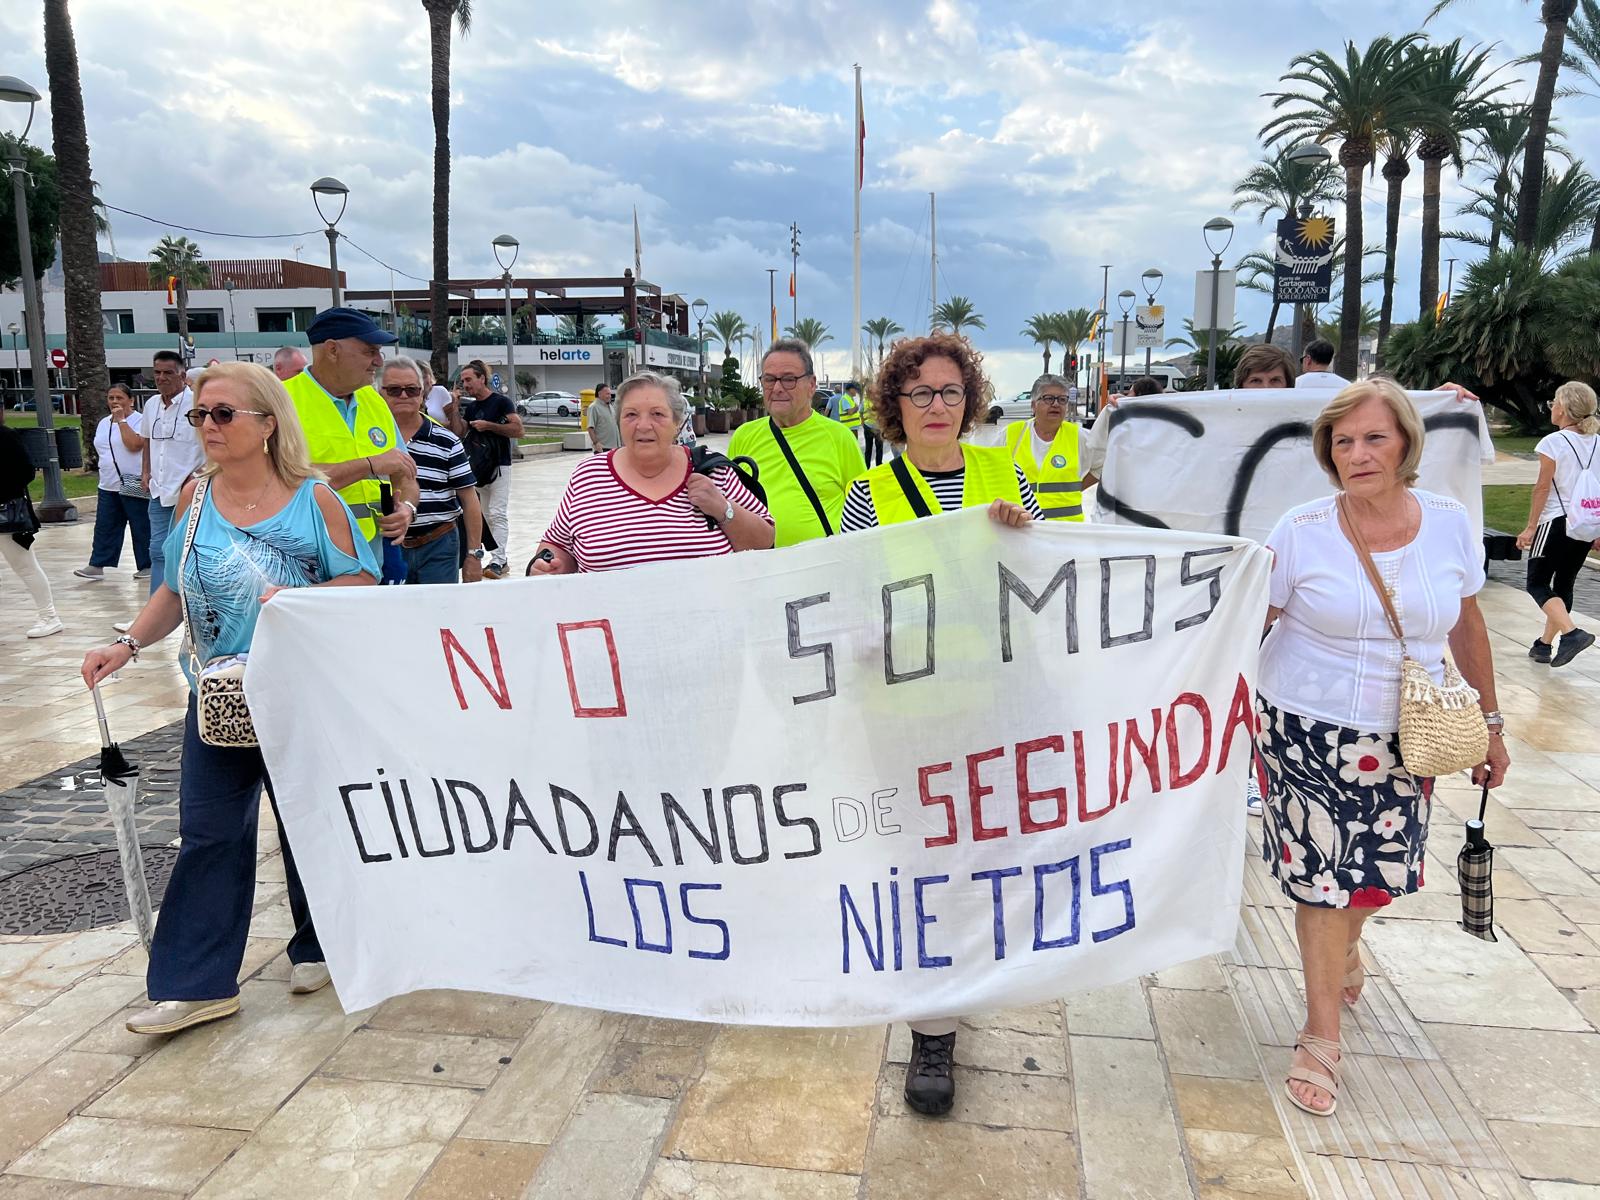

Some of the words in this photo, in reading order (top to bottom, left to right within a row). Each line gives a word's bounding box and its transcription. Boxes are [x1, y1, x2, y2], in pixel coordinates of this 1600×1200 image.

[1278, 280, 1316, 288] Cartagena
[540, 348, 591, 361] helarte
[194, 479, 207, 505] LOLA
[439, 619, 627, 718] NO
[785, 546, 1234, 705] SOMOS
[832, 787, 901, 842] DE
[918, 672, 1254, 848] SEGUNDA
[579, 871, 731, 960] LOS
